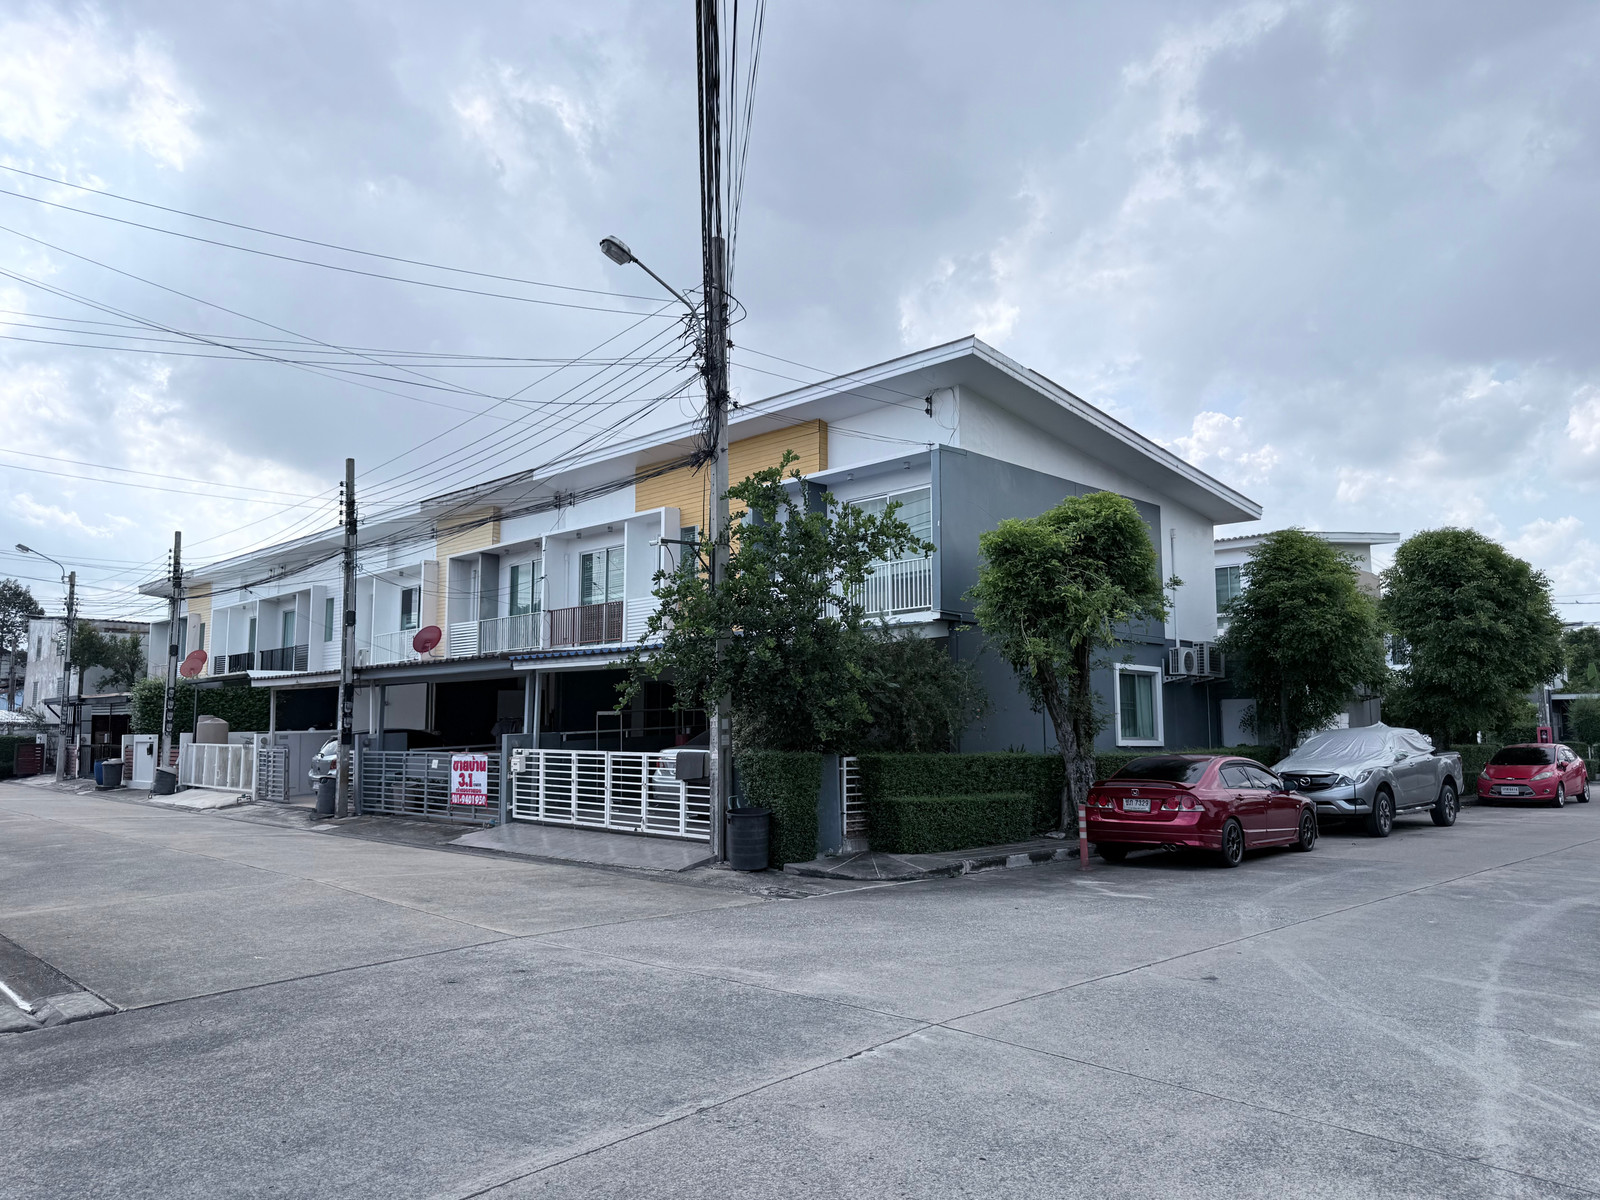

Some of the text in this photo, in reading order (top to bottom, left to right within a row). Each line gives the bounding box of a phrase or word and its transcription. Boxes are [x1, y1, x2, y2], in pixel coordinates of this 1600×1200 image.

[453, 756, 486, 772] ขายบ้าน
[458, 772, 473, 787] 3.1
